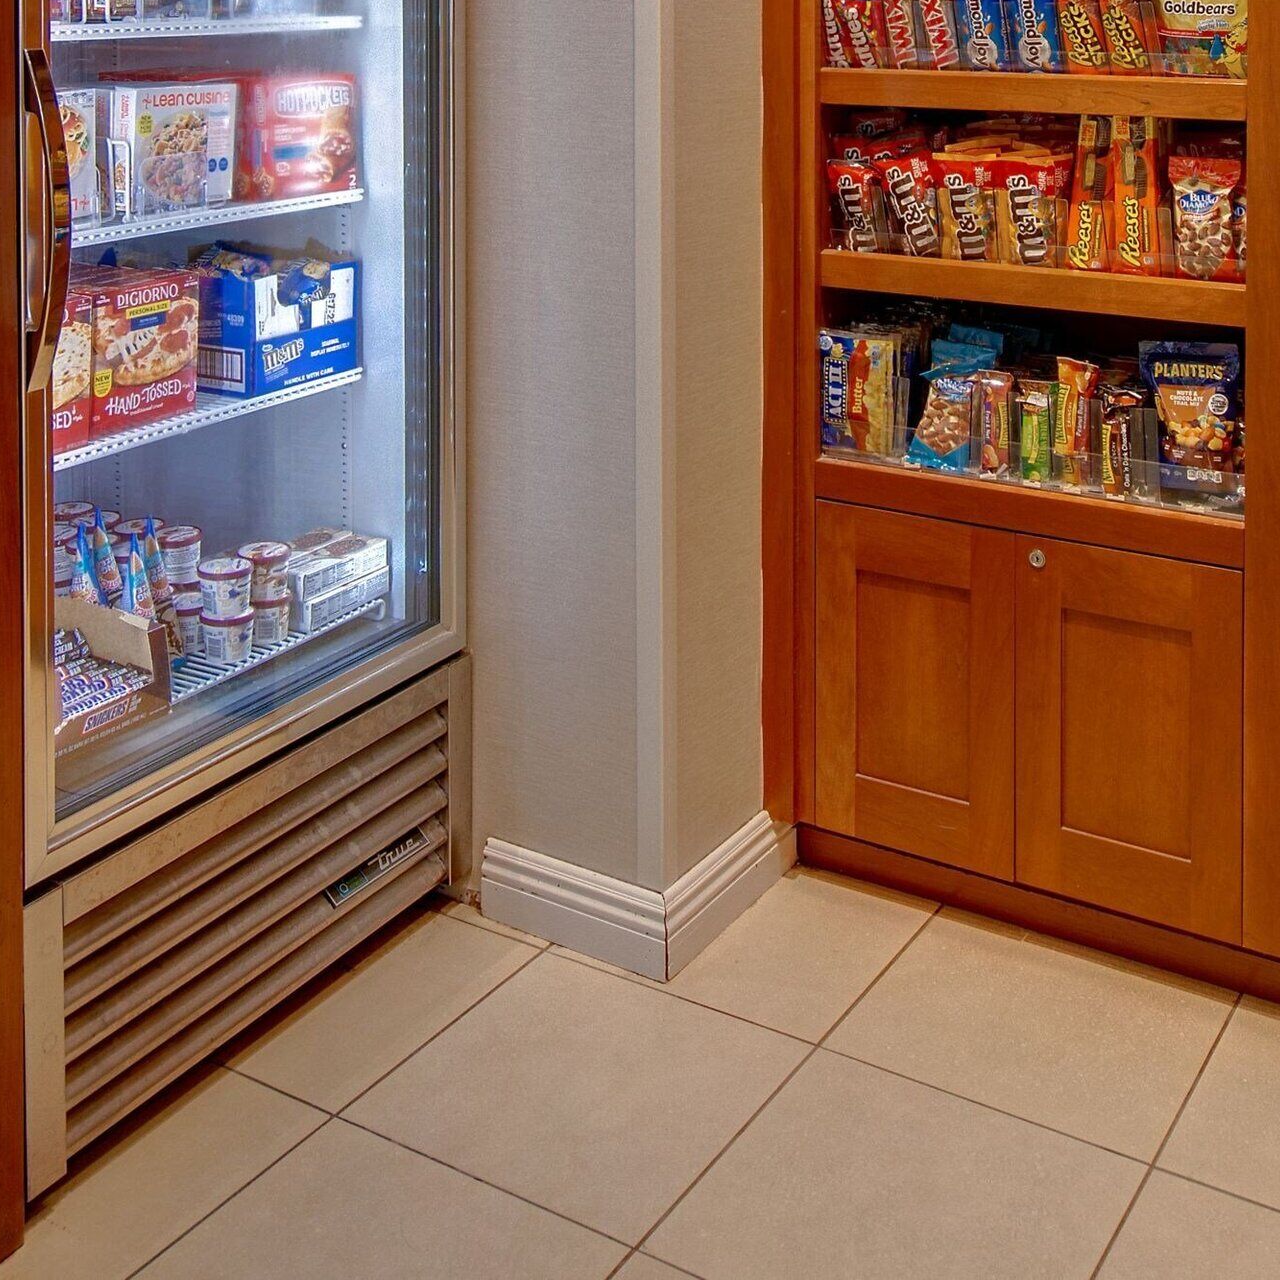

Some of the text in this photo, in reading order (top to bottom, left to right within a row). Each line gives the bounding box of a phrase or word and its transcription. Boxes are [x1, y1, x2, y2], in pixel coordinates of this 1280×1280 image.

[1164, 0, 1236, 16] Goldbears
[972, 36, 991, 68] Joy
[1022, 36, 1043, 69] Joy
[153, 93, 184, 108] Lean
[349, 174, 357, 186] 2
[1189, 192, 1213, 203] BLUE
[1069, 200, 1094, 269] Reese's
[1119, 196, 1140, 267] Reese's
[128, 302, 169, 318] PERSONAL SIZE
[95, 375, 111, 383] NEW
[284, 366, 335, 387] HANDLE WITH CARE
[1154, 361, 1224, 380] PLANTERS
[105, 378, 182, 417] HAND-TOSSED
[829, 385, 844, 420] ACT
[852, 376, 865, 415] Butter
[1176, 389, 1193, 397] NUTS
